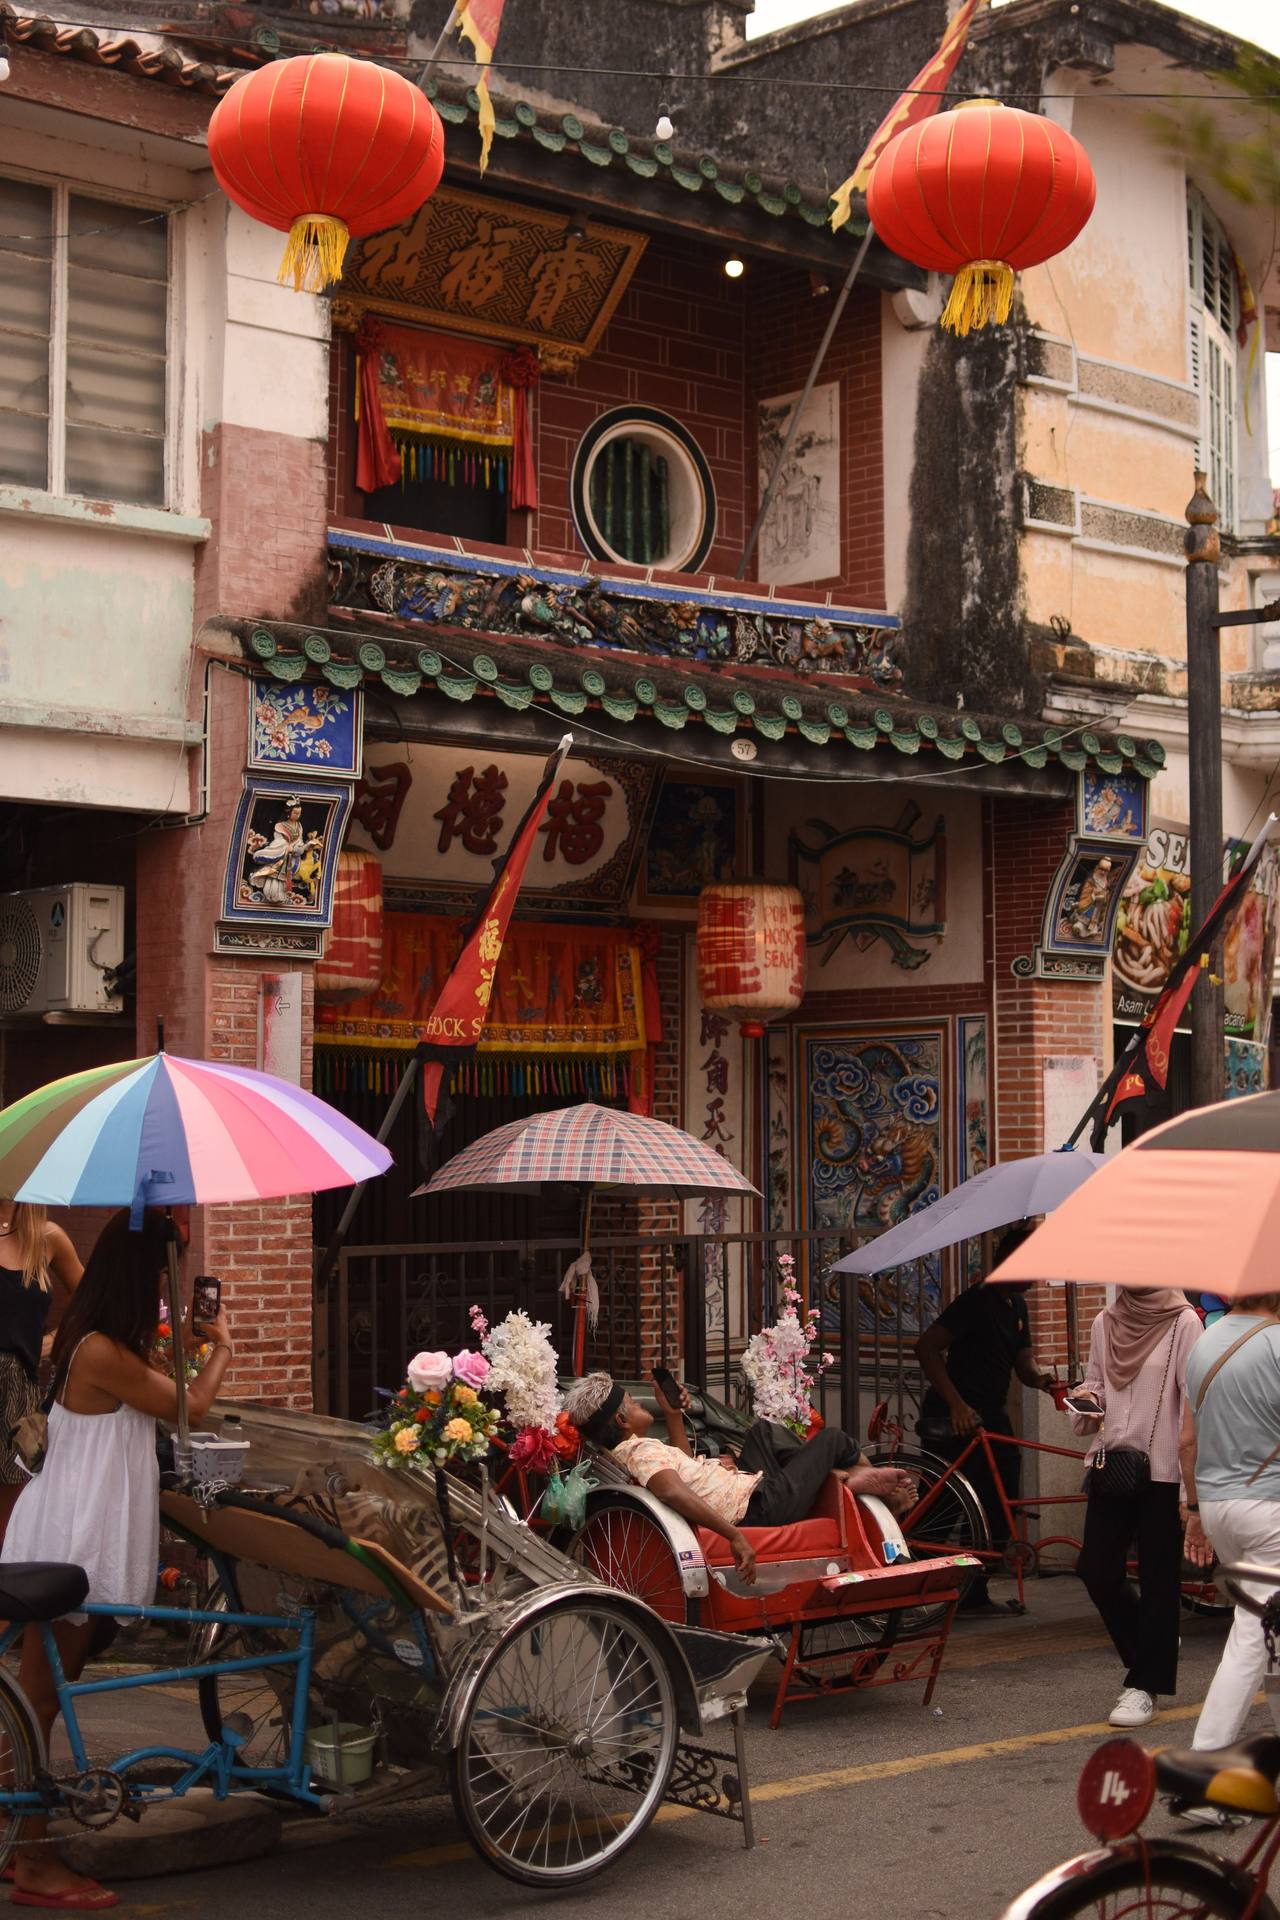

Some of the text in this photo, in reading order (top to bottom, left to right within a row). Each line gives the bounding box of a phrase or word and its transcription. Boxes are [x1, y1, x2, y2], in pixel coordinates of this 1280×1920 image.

[737, 742, 752, 756] 57
[1146, 827, 1192, 877] SE
[763, 905, 788, 924] POH
[764, 950, 795, 970] SEAH
[1117, 994, 1144, 1014] Asam
[471, 1015, 486, 1037] S
[1223, 1013, 1247, 1031] acang
[1100, 1770, 1131, 1806] 14
